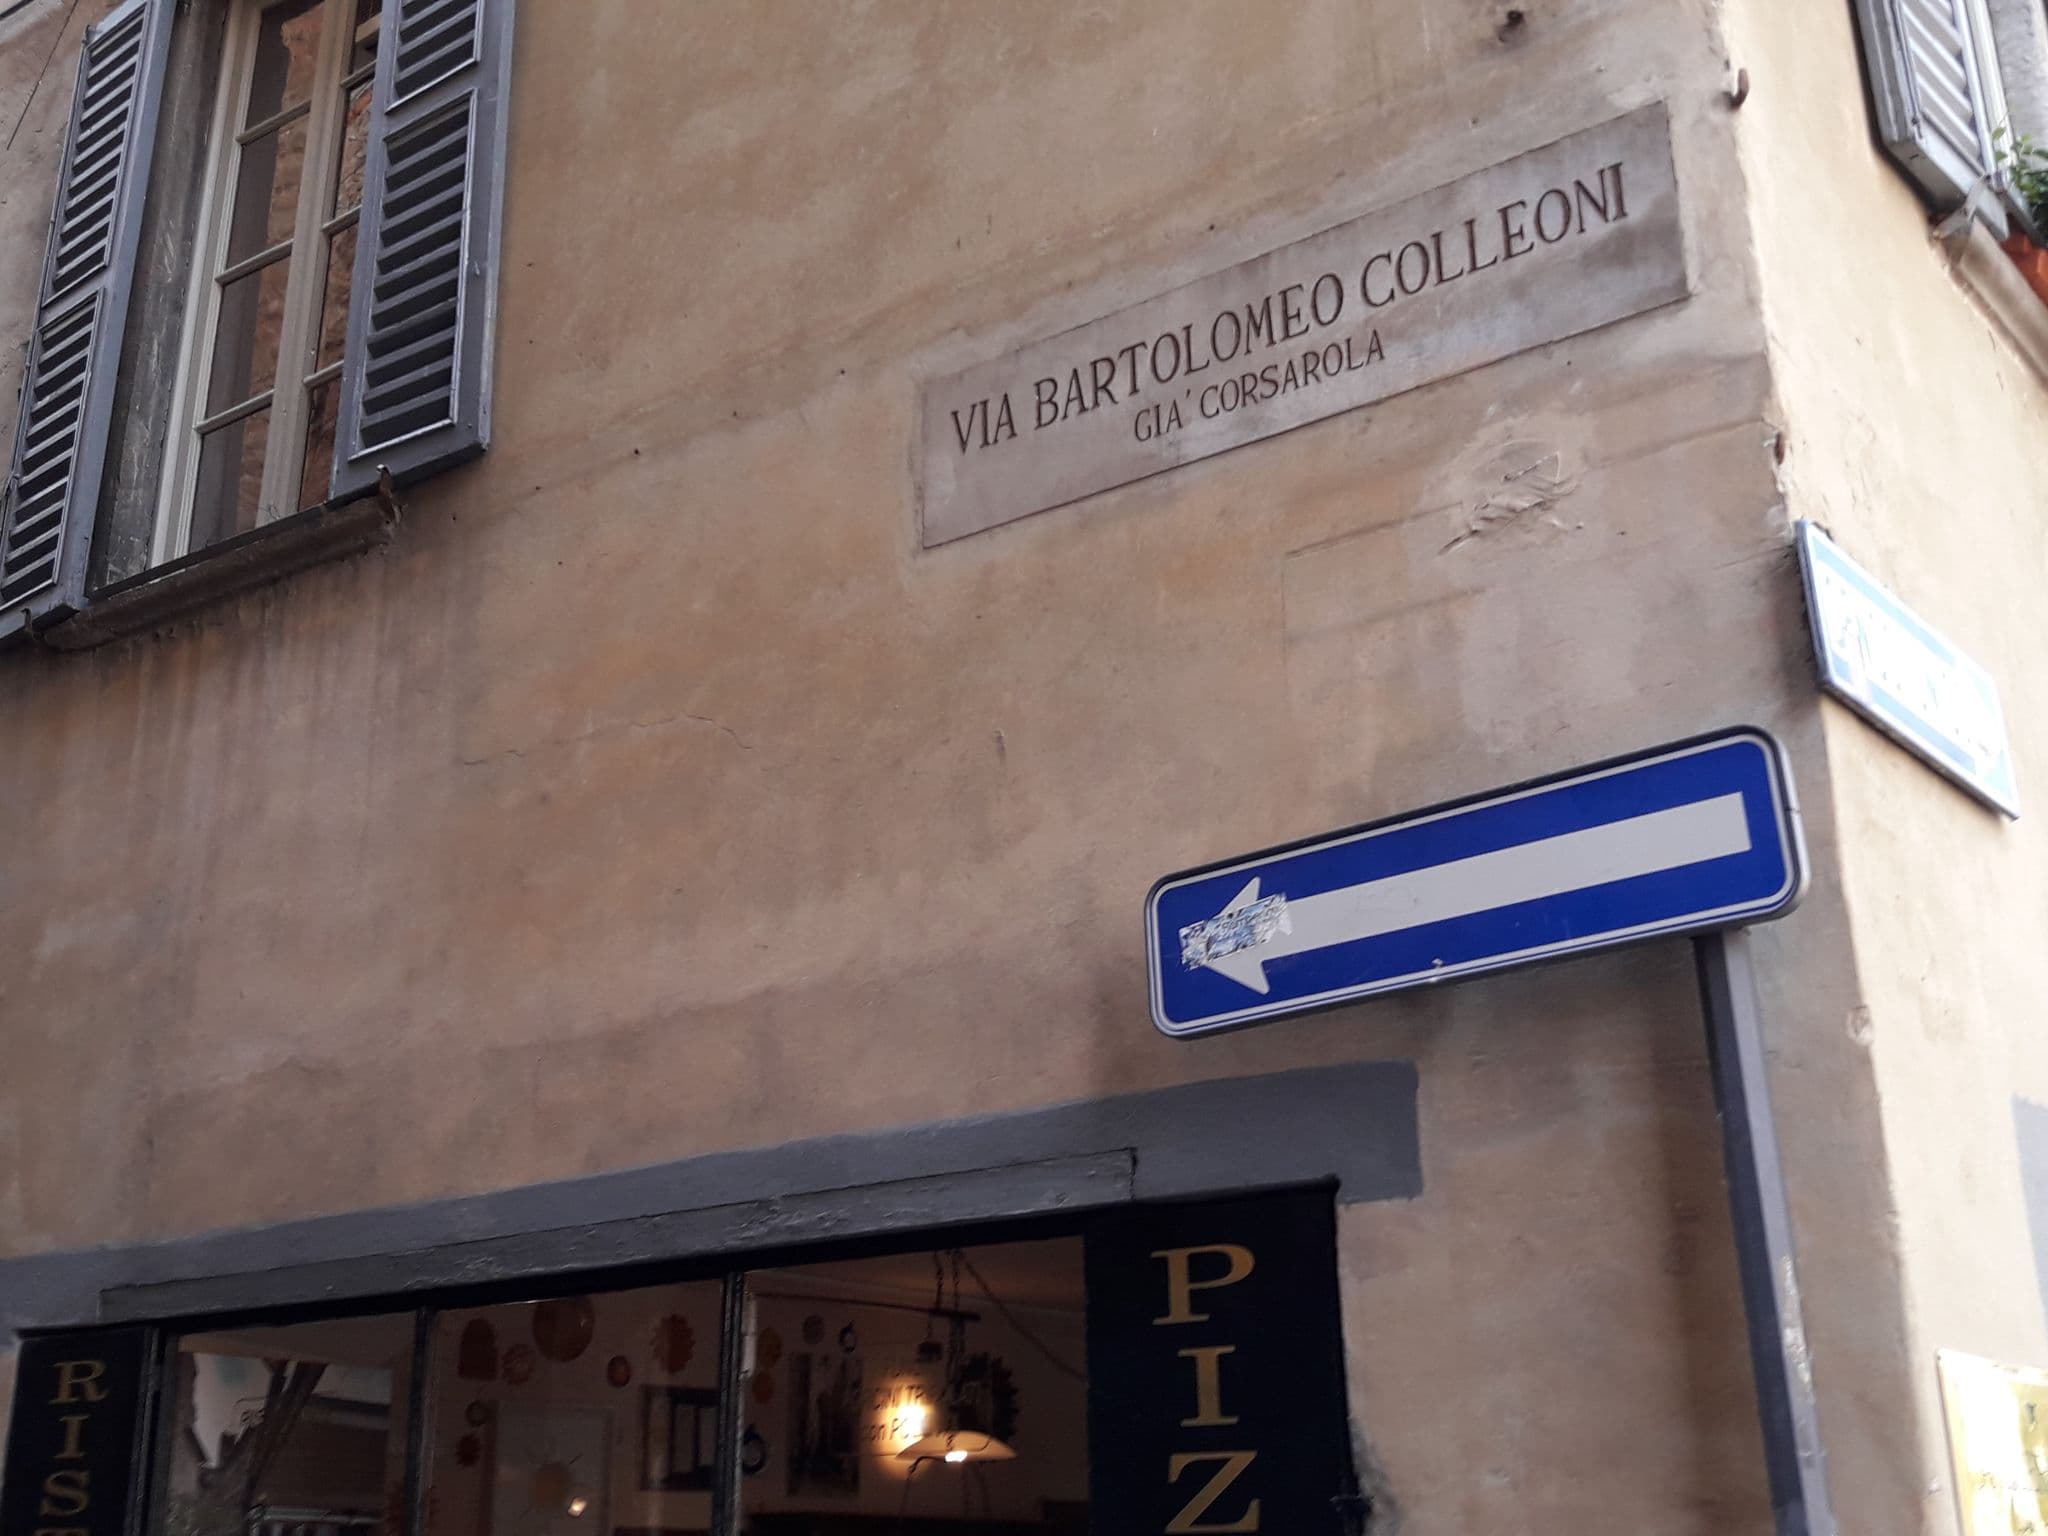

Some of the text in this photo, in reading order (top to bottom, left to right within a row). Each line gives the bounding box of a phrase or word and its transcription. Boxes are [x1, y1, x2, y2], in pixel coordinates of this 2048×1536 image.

[949, 161, 1630, 456] VIA BARTOLOMEO COLLEONI
[1199, 329, 1386, 421] CORSAROLA
[33, 1359, 110, 1536] RIS
